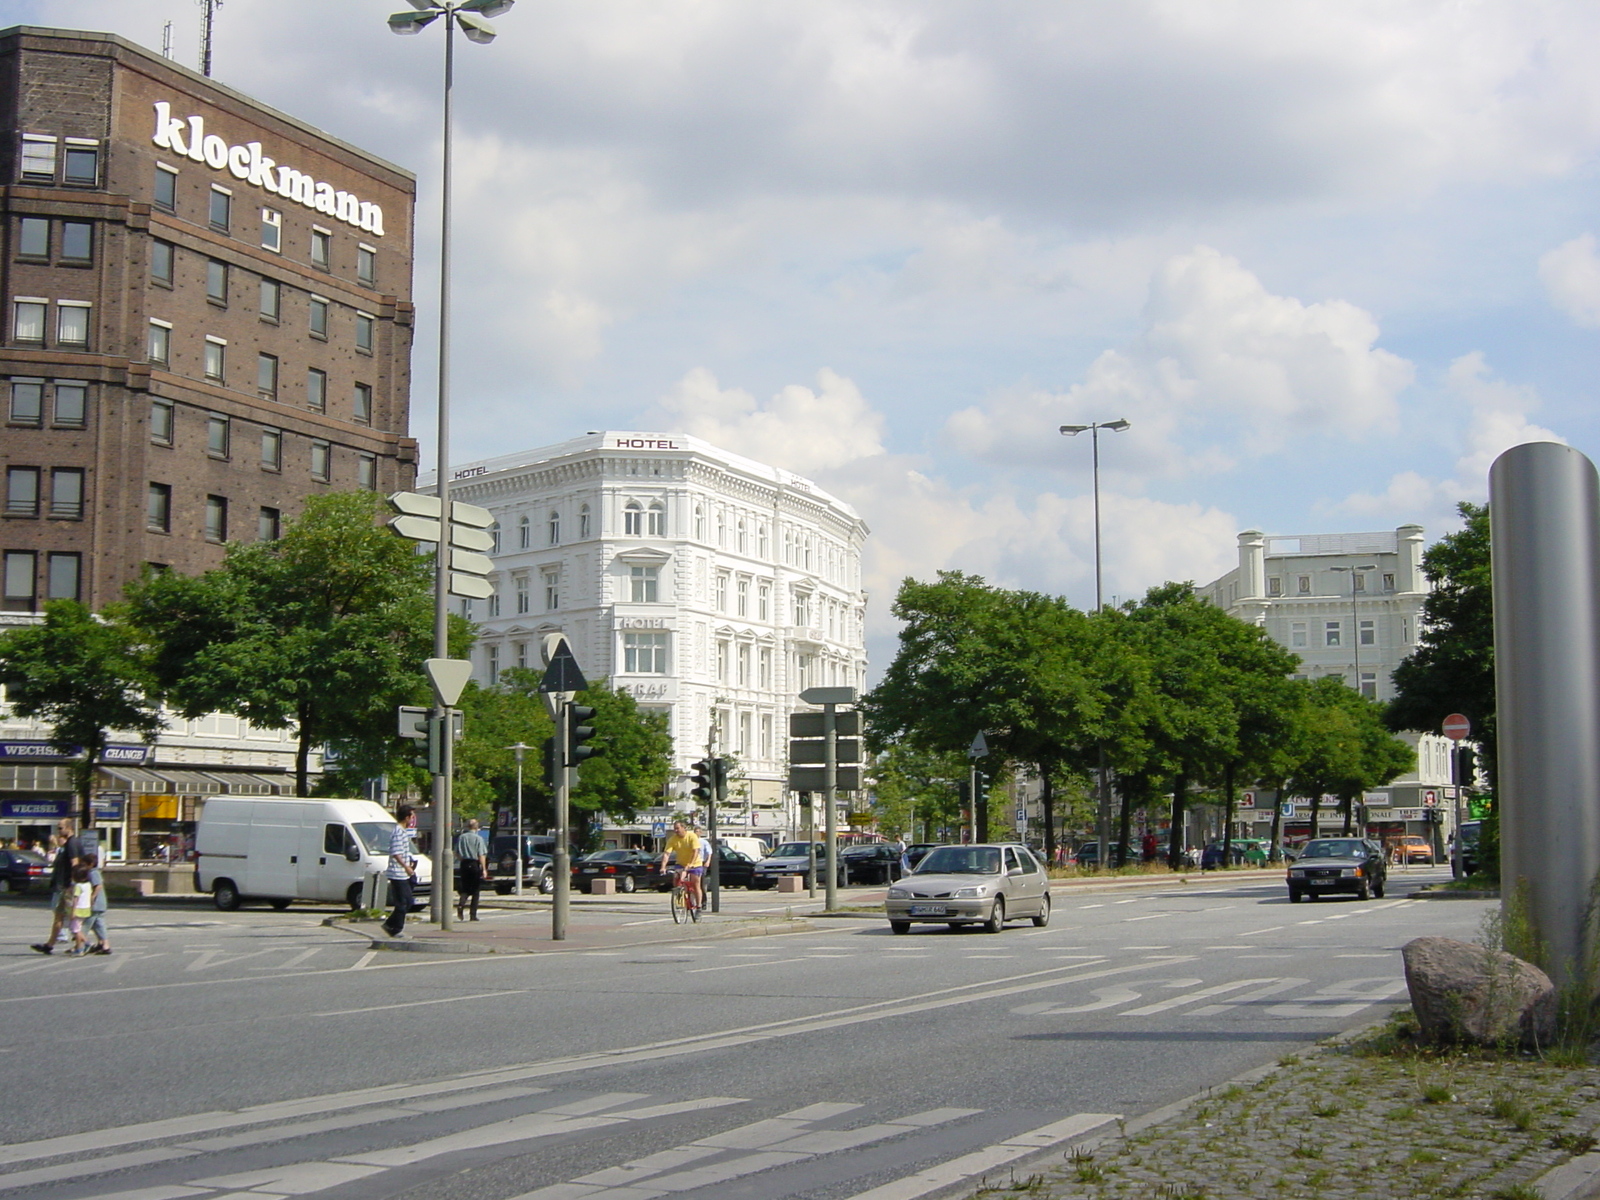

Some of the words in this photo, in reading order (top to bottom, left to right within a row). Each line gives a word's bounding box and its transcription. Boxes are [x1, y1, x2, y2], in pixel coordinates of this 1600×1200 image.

[153, 101, 385, 237] klockmann
[616, 438, 679, 449] HOTEL
[454, 465, 489, 479] HOTEL
[105, 748, 144, 759] CHANGE
[11, 804, 59, 813] WECHSEL
